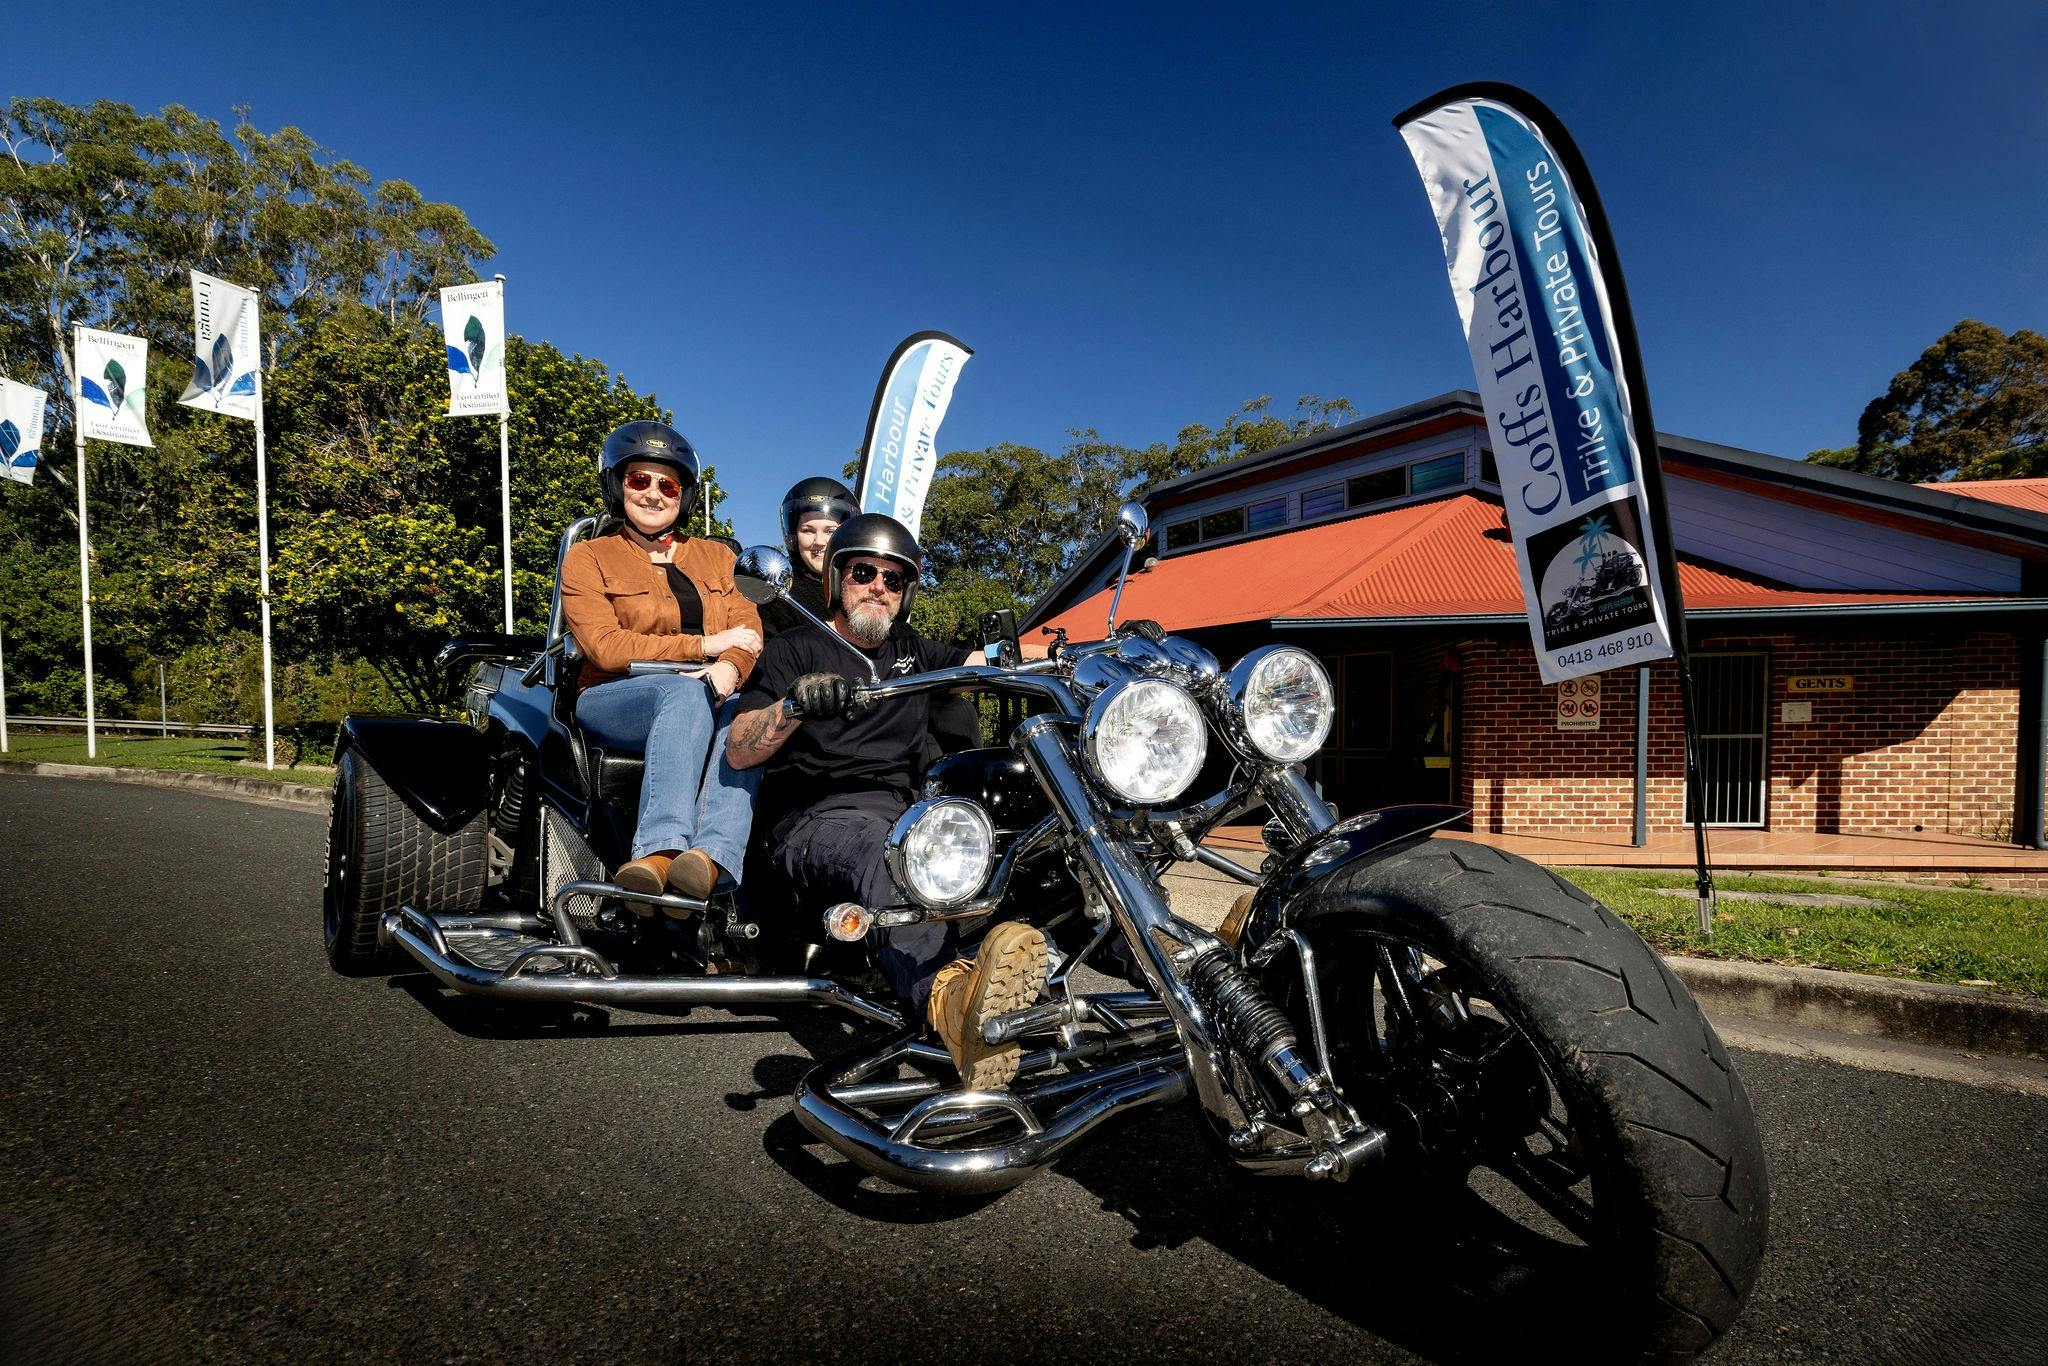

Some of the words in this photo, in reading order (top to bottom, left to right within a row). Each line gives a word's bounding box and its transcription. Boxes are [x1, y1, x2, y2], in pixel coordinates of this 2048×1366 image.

[1526, 159, 1562, 253] Tours
[446, 290, 489, 304] Bellingen
[1462, 170, 1534, 385] Harbour
[1545, 249, 1588, 368] Private
[197, 280, 212, 342] Urunga
[87, 334, 136, 351] Bellingen
[458, 401, 500, 410] Destination
[1565, 369, 1595, 400] &
[875, 395, 908, 505] Harbour
[901, 506, 914, 526] &
[921, 352, 954, 410] Tours
[1498, 383, 1563, 516] Coffs
[1576, 406, 1611, 492] Trike
[1545, 622, 1571, 638] TRIKE
[1574, 621, 1580, 630] &
[1582, 610, 1620, 628] PRIVATE
[1622, 601, 1649, 615] TOURS
[1557, 648, 1593, 668] 0418
[1597, 640, 1624, 659] 468
[1626, 631, 1654, 651] 910
[1795, 677, 1847, 689] GENTS
